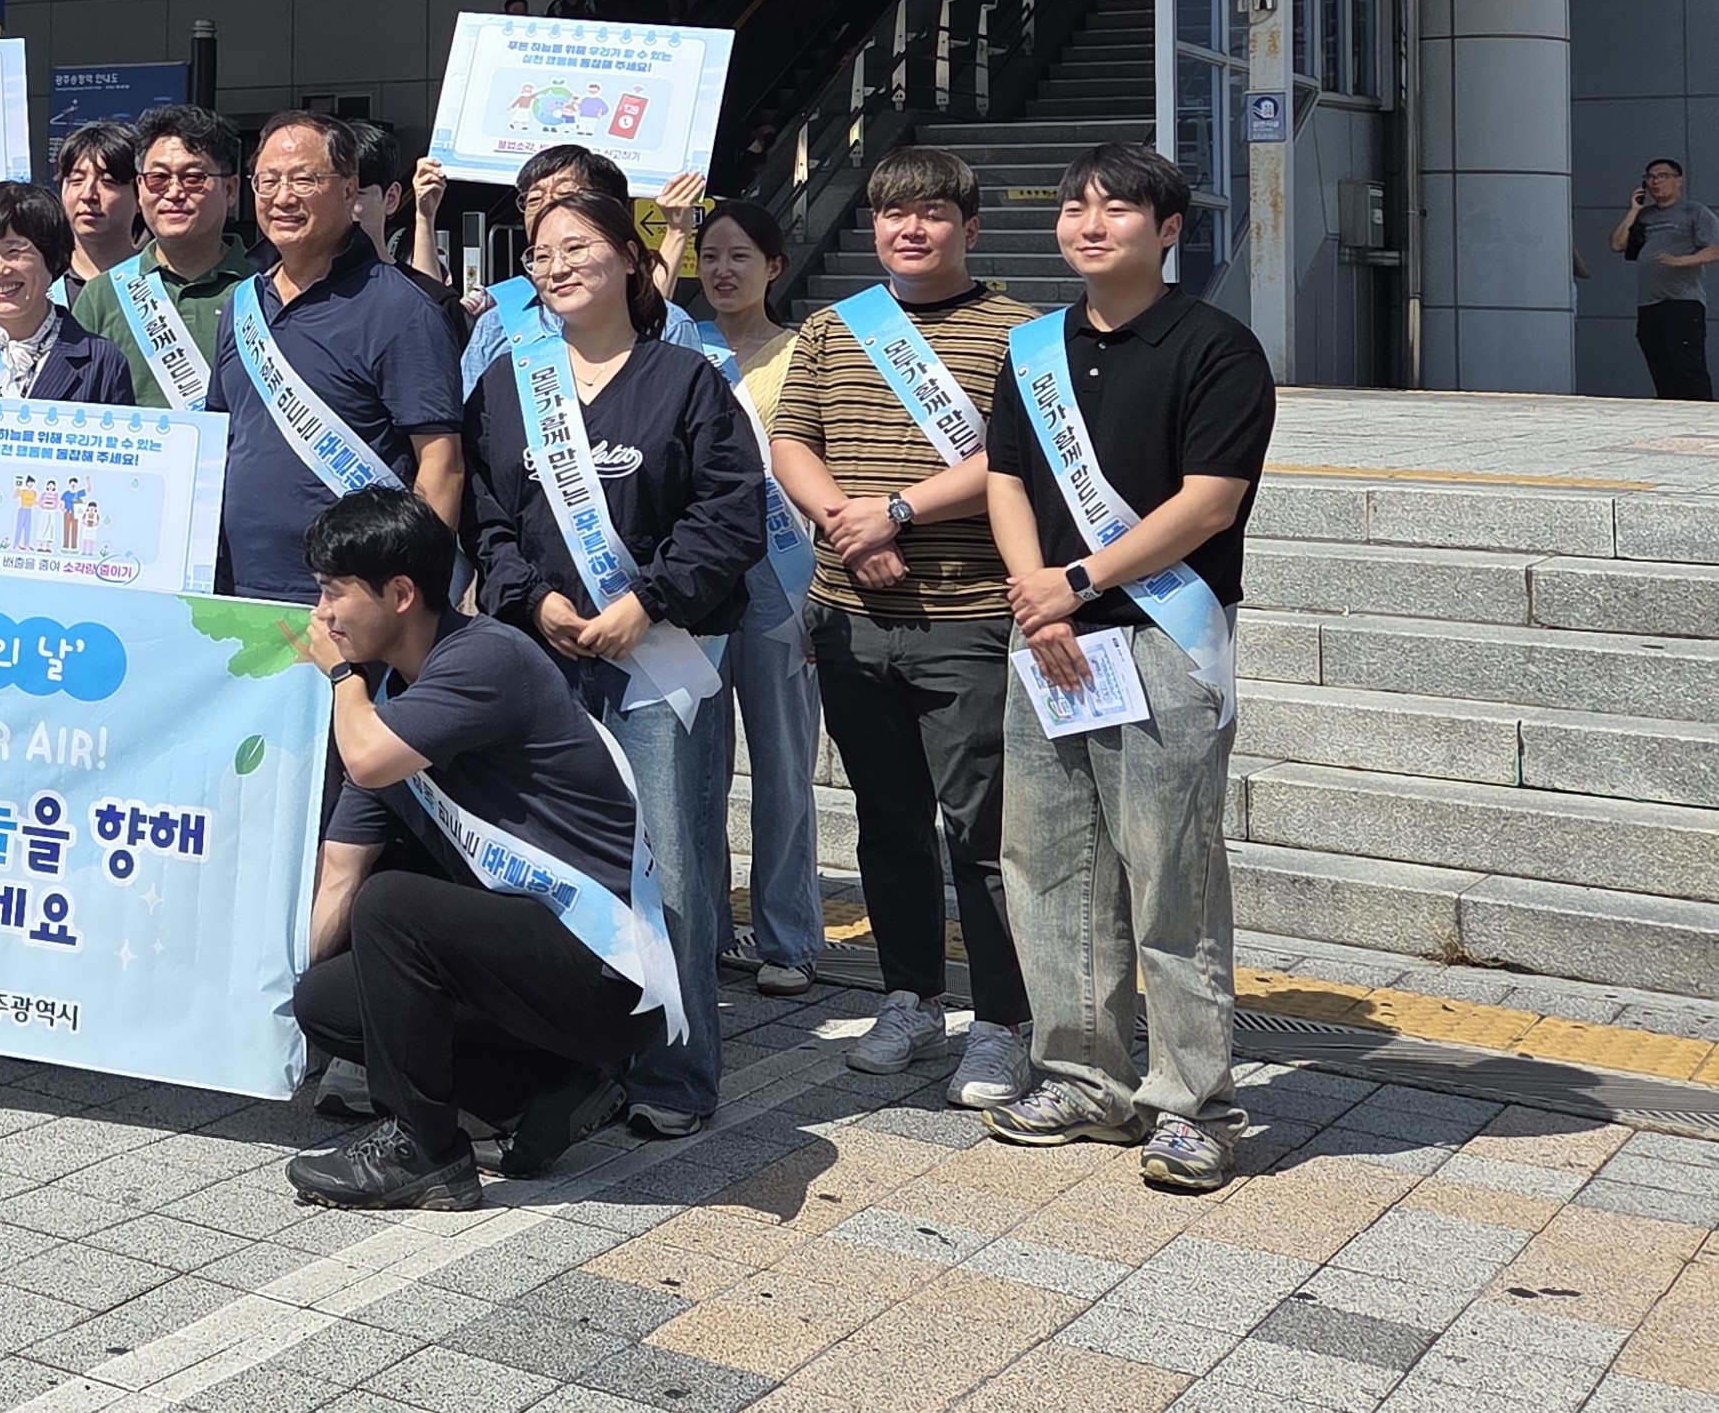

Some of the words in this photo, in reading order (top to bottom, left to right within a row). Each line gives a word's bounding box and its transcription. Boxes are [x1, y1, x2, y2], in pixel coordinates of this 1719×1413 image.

[506, 40, 530, 52] 푸른
[530, 41, 563, 54] 하늘을
[565, 43, 587, 55] 위해
[588, 45, 622, 57] 우리가
[623, 47, 635, 59] 할
[636, 48, 648, 60] 수
[649, 49, 673, 62] 있는
[521, 53, 544, 65] 실천
[614, 59, 653, 73] 주세요!
[95, 72, 119, 84] 안내도
[497, 139, 537, 153] 불법소각,
[144, 314, 178, 352] 함께
[161, 347, 204, 399] 만드는
[240, 312, 266, 366] 모두가
[258, 356, 284, 397] 함께
[276, 386, 323, 443] 만드는
[882, 337, 929, 386] 모두가
[911, 377, 953, 416] 함께
[530, 364, 566, 416] 모두가
[37, 431, 62, 445] 위해
[64, 432, 103, 449] 우리가
[105, 435, 119, 450] 할
[120, 436, 134, 451] 수
[136, 437, 162, 453] 있는
[538, 412, 573, 448] 함께
[1031, 371, 1067, 431] 모두가
[1051, 424, 1084, 469] 함께
[1070, 464, 1110, 526] 만드는
[55, 447, 94, 463] 동참해
[95, 450, 140, 467] 주세요!
[547, 447, 592, 508] 만드는
[2, 554, 36, 570] 배출을
[37, 557, 61, 573] 줄여
[62, 560, 98, 576] 소각량
[98, 562, 133, 579] 줄이기
[570, 507, 634, 596] 푸른하늘
[26, 720, 109, 771] AIR!
[94, 803, 207, 880] 향해
[438, 800, 481, 859] 만드는
[481, 840, 582, 914] 푸른하늘
